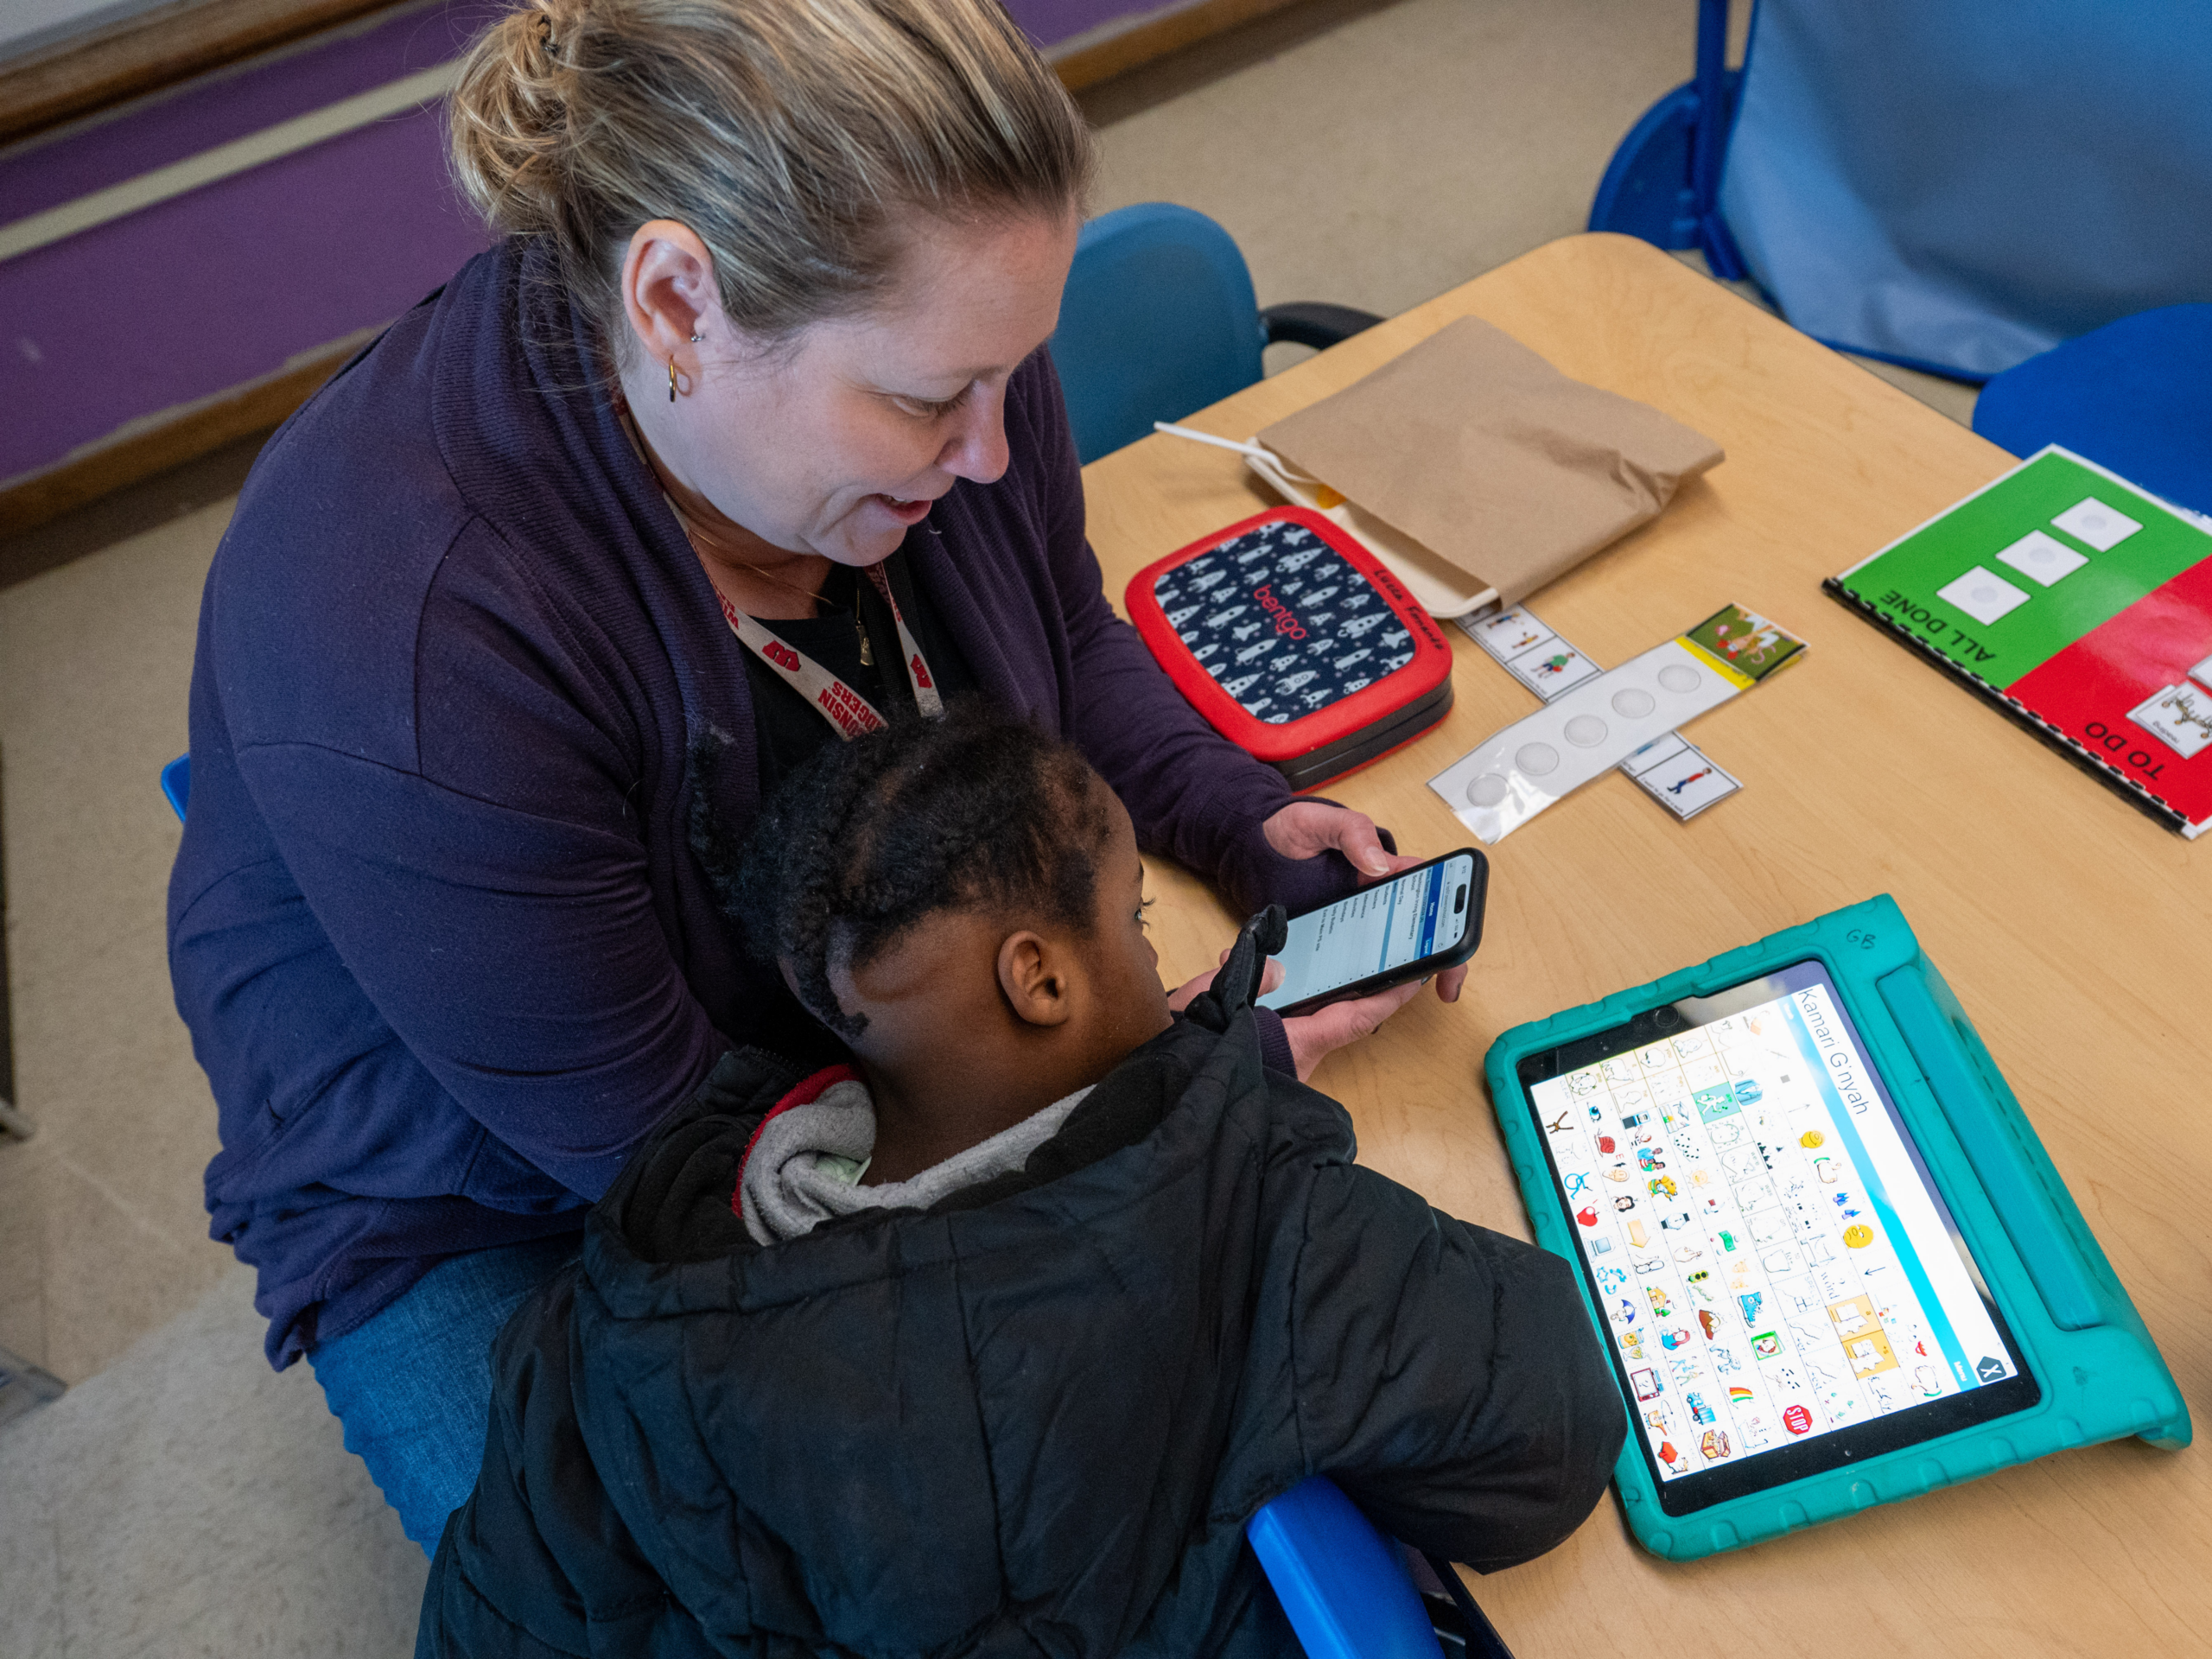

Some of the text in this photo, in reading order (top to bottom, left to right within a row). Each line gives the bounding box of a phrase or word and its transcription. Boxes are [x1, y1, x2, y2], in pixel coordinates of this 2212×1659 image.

[1254, 584, 1307, 640] bentgo
[1879, 589, 1997, 663] ALL DONE
[2085, 721, 2165, 781] TO DO
[1370, 888, 1379, 910] Teachers
[1796, 988, 1839, 1048] Kamari
[1953, 1361, 1968, 1382] Menu
[1786, 1407, 1808, 1433] STOP
